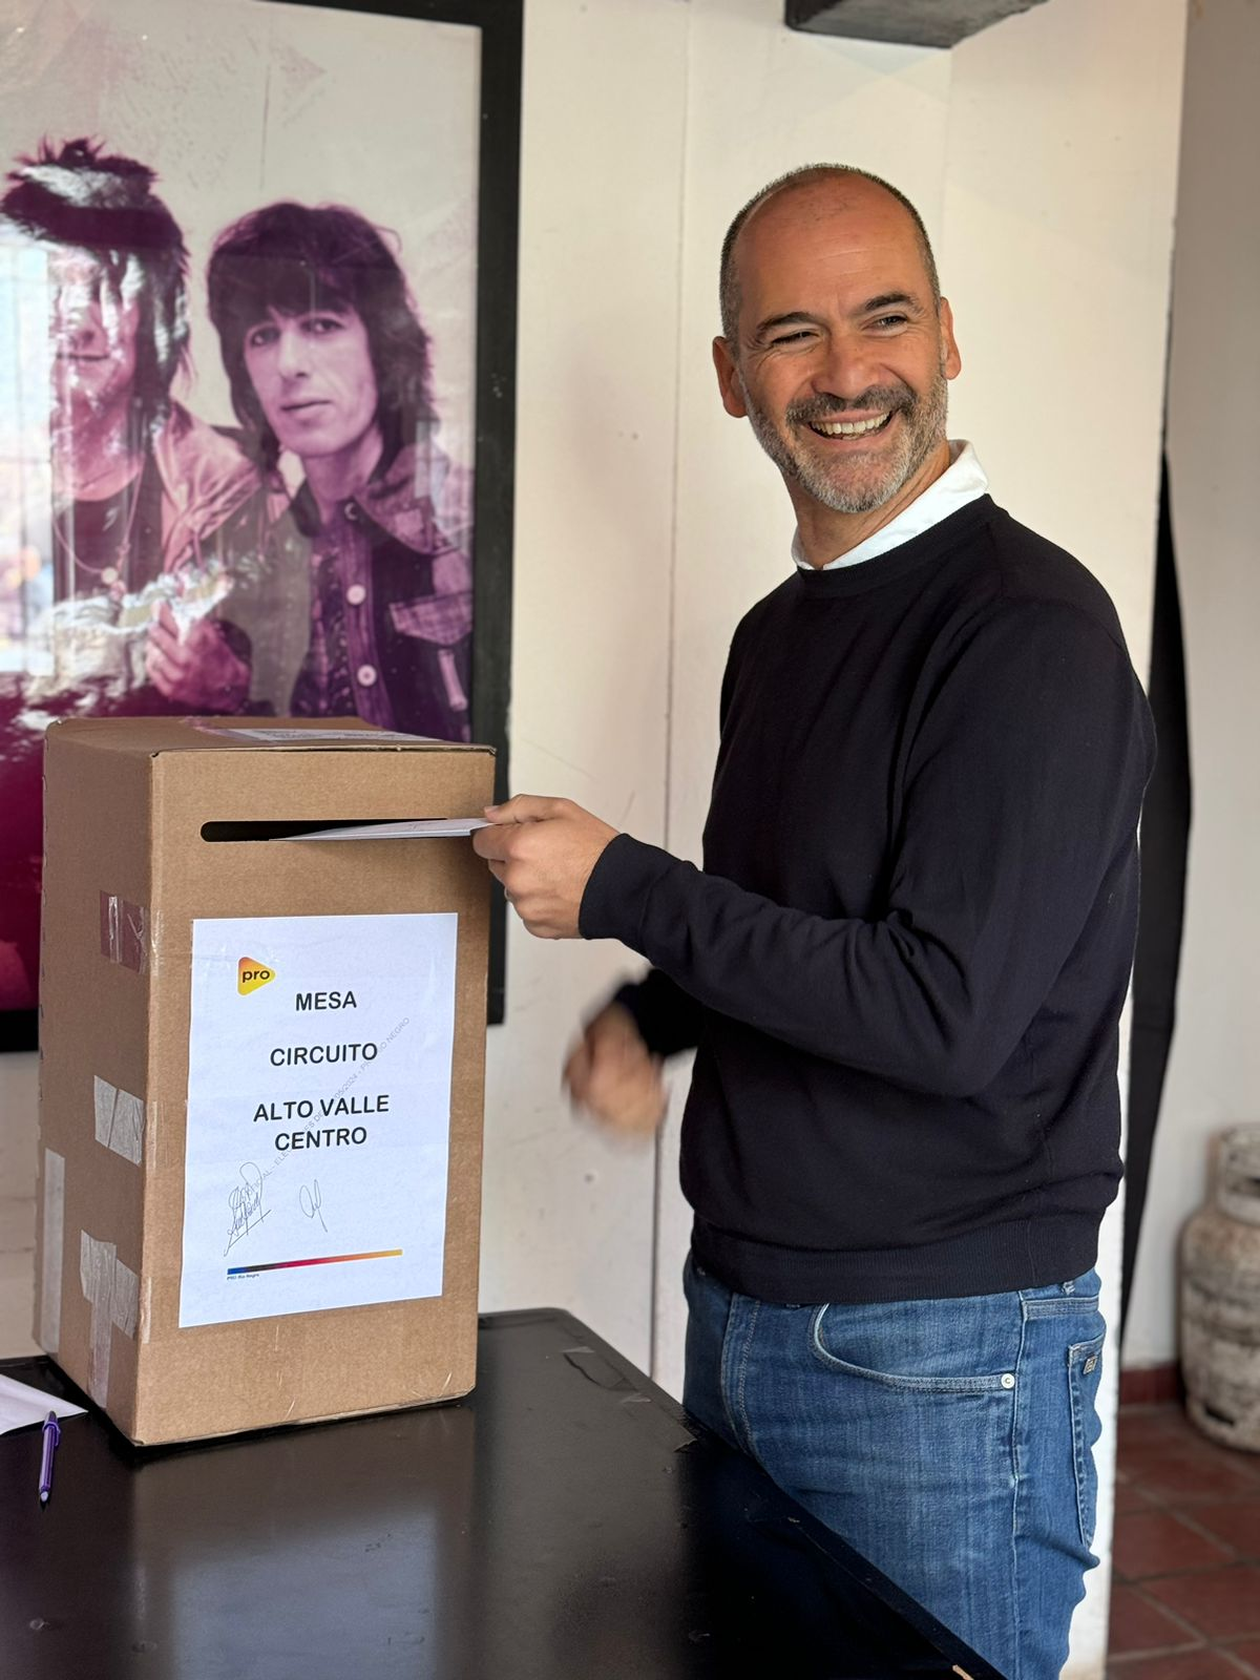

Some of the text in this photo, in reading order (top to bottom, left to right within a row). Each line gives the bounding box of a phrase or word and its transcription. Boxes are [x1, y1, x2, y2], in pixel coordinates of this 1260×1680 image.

[241, 969, 271, 983] pro
[295, 991, 357, 1011] MESA
[269, 1042, 378, 1066] CIRCUITO
[254, 1095, 389, 1122] ALTO VALLE
[275, 1126, 367, 1151] CENTRO
